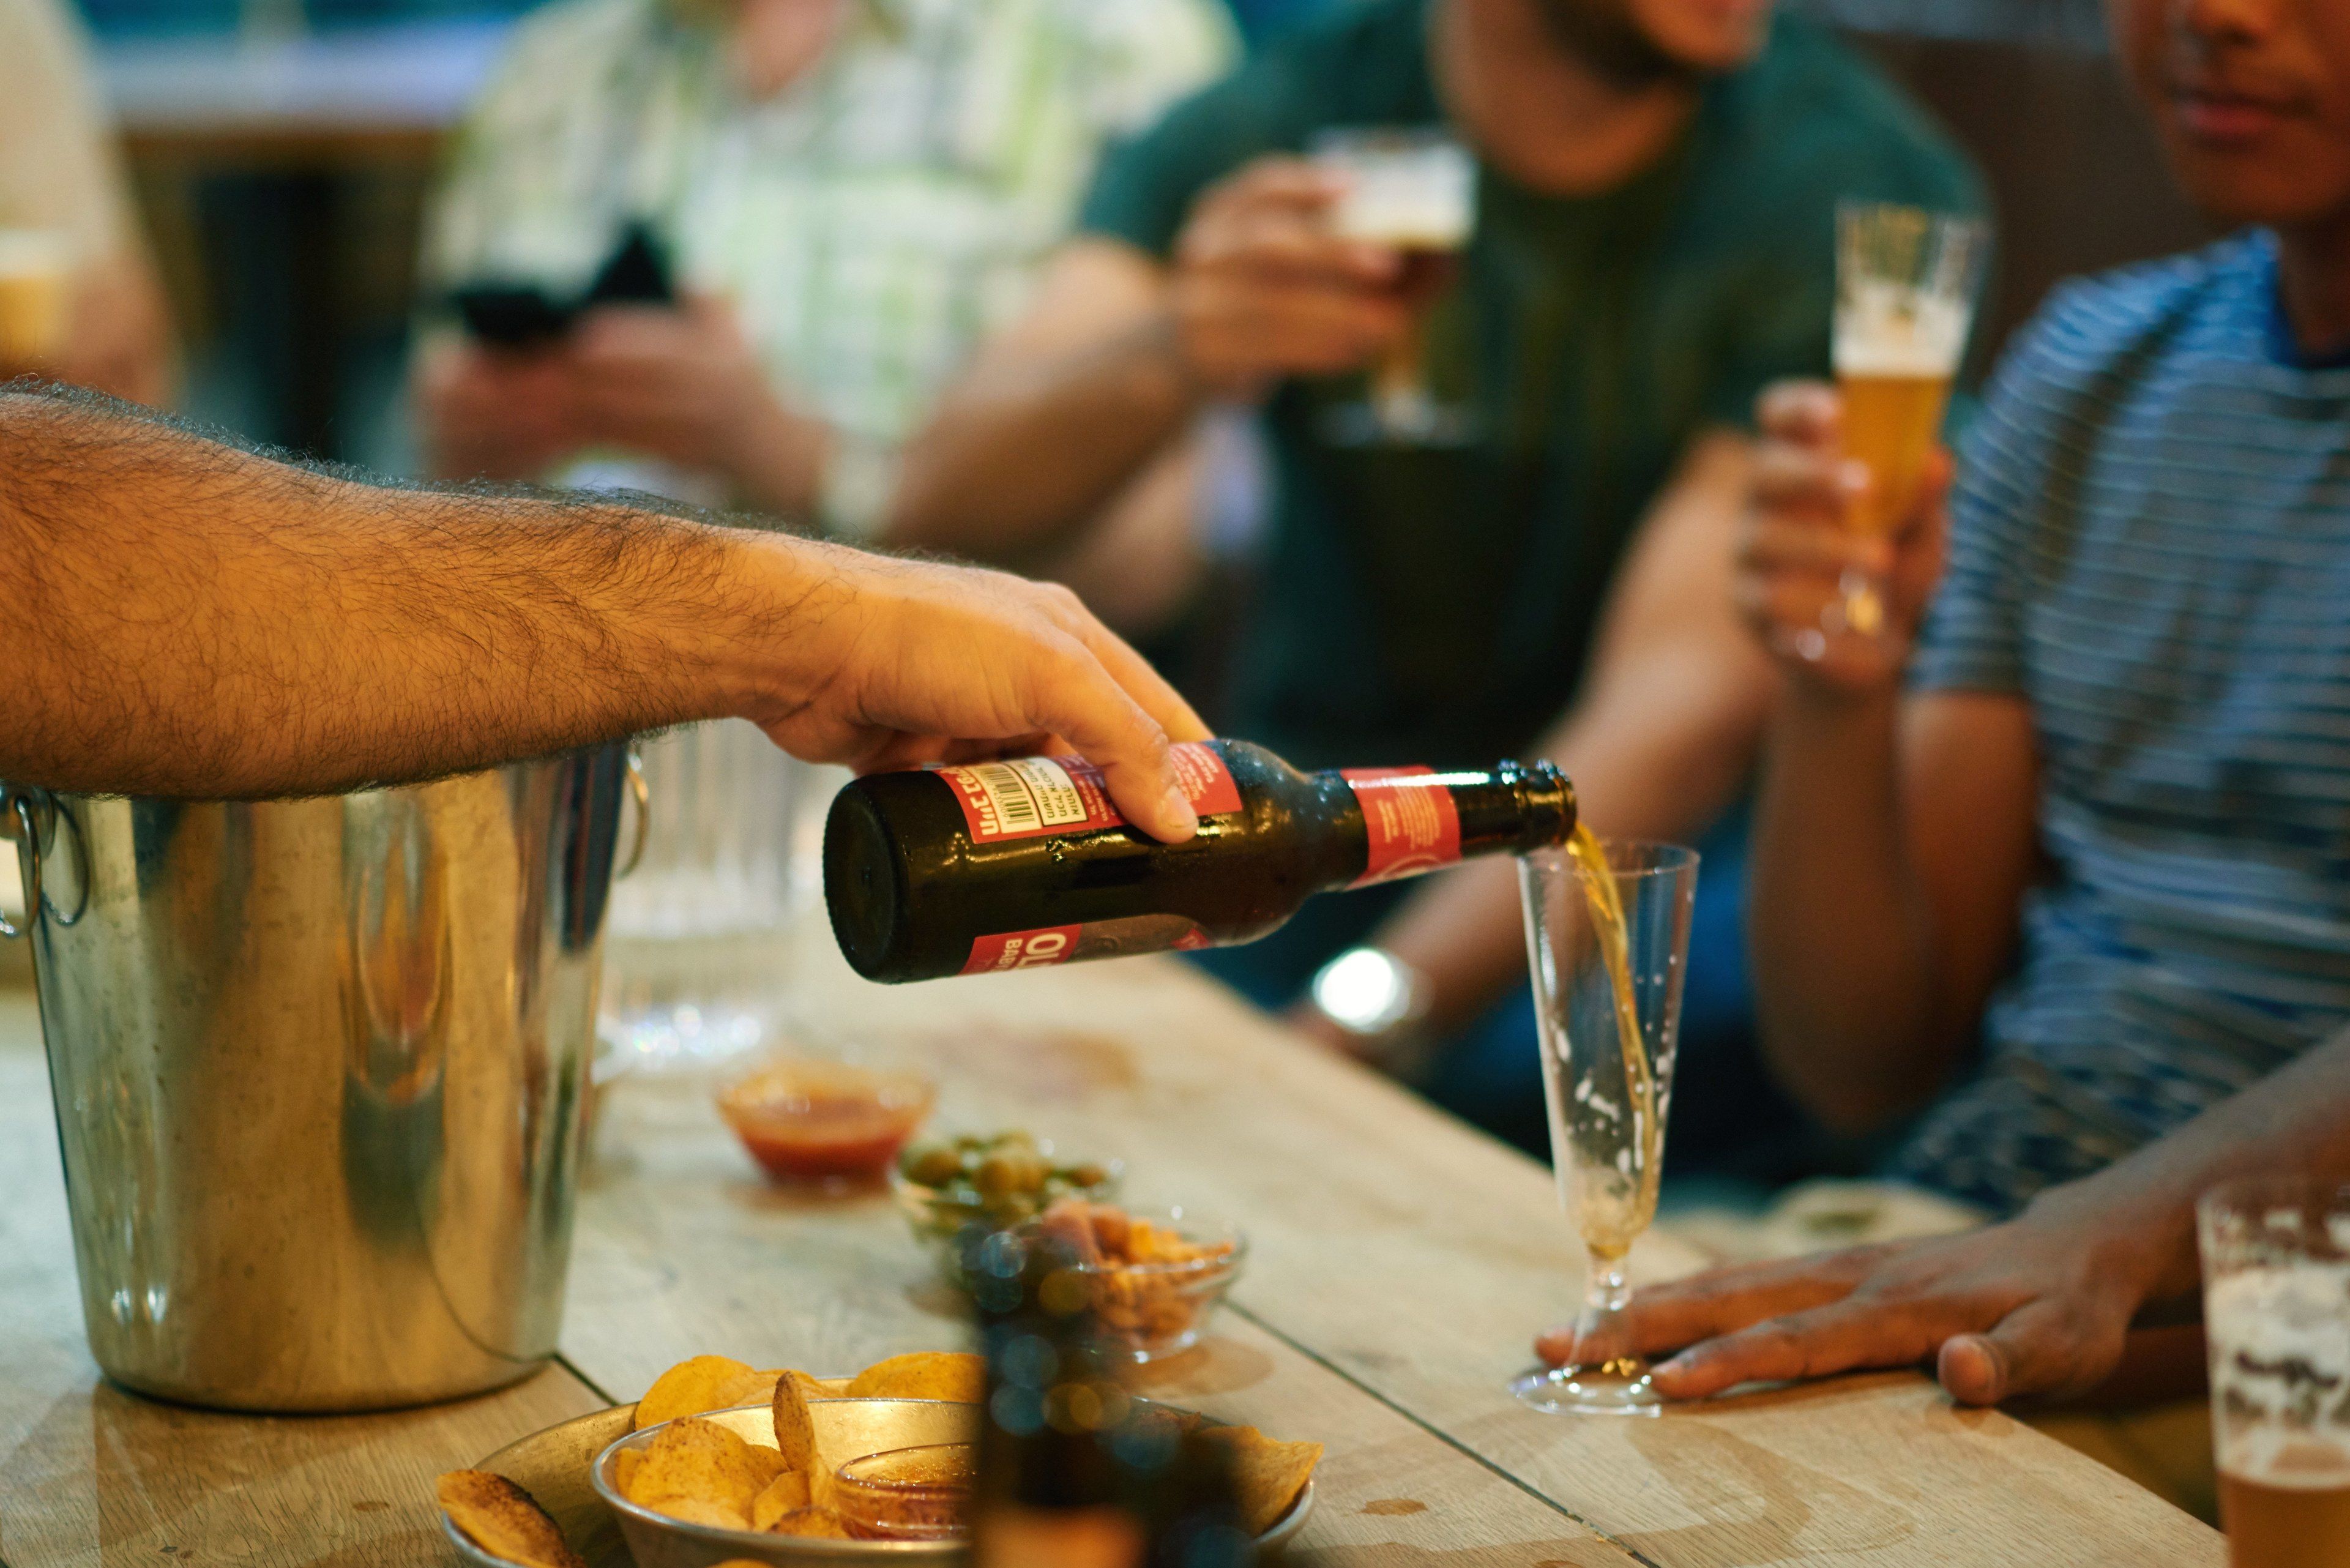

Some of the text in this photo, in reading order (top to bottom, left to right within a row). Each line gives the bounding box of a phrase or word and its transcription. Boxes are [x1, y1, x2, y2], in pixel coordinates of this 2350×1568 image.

[969, 795, 999, 835] חייב
[1034, 785, 1056, 819] משתייה
[1054, 795, 1068, 818] מכיל
[1061, 784, 1080, 816] אזהרה:
[1016, 933, 1067, 968] OL
